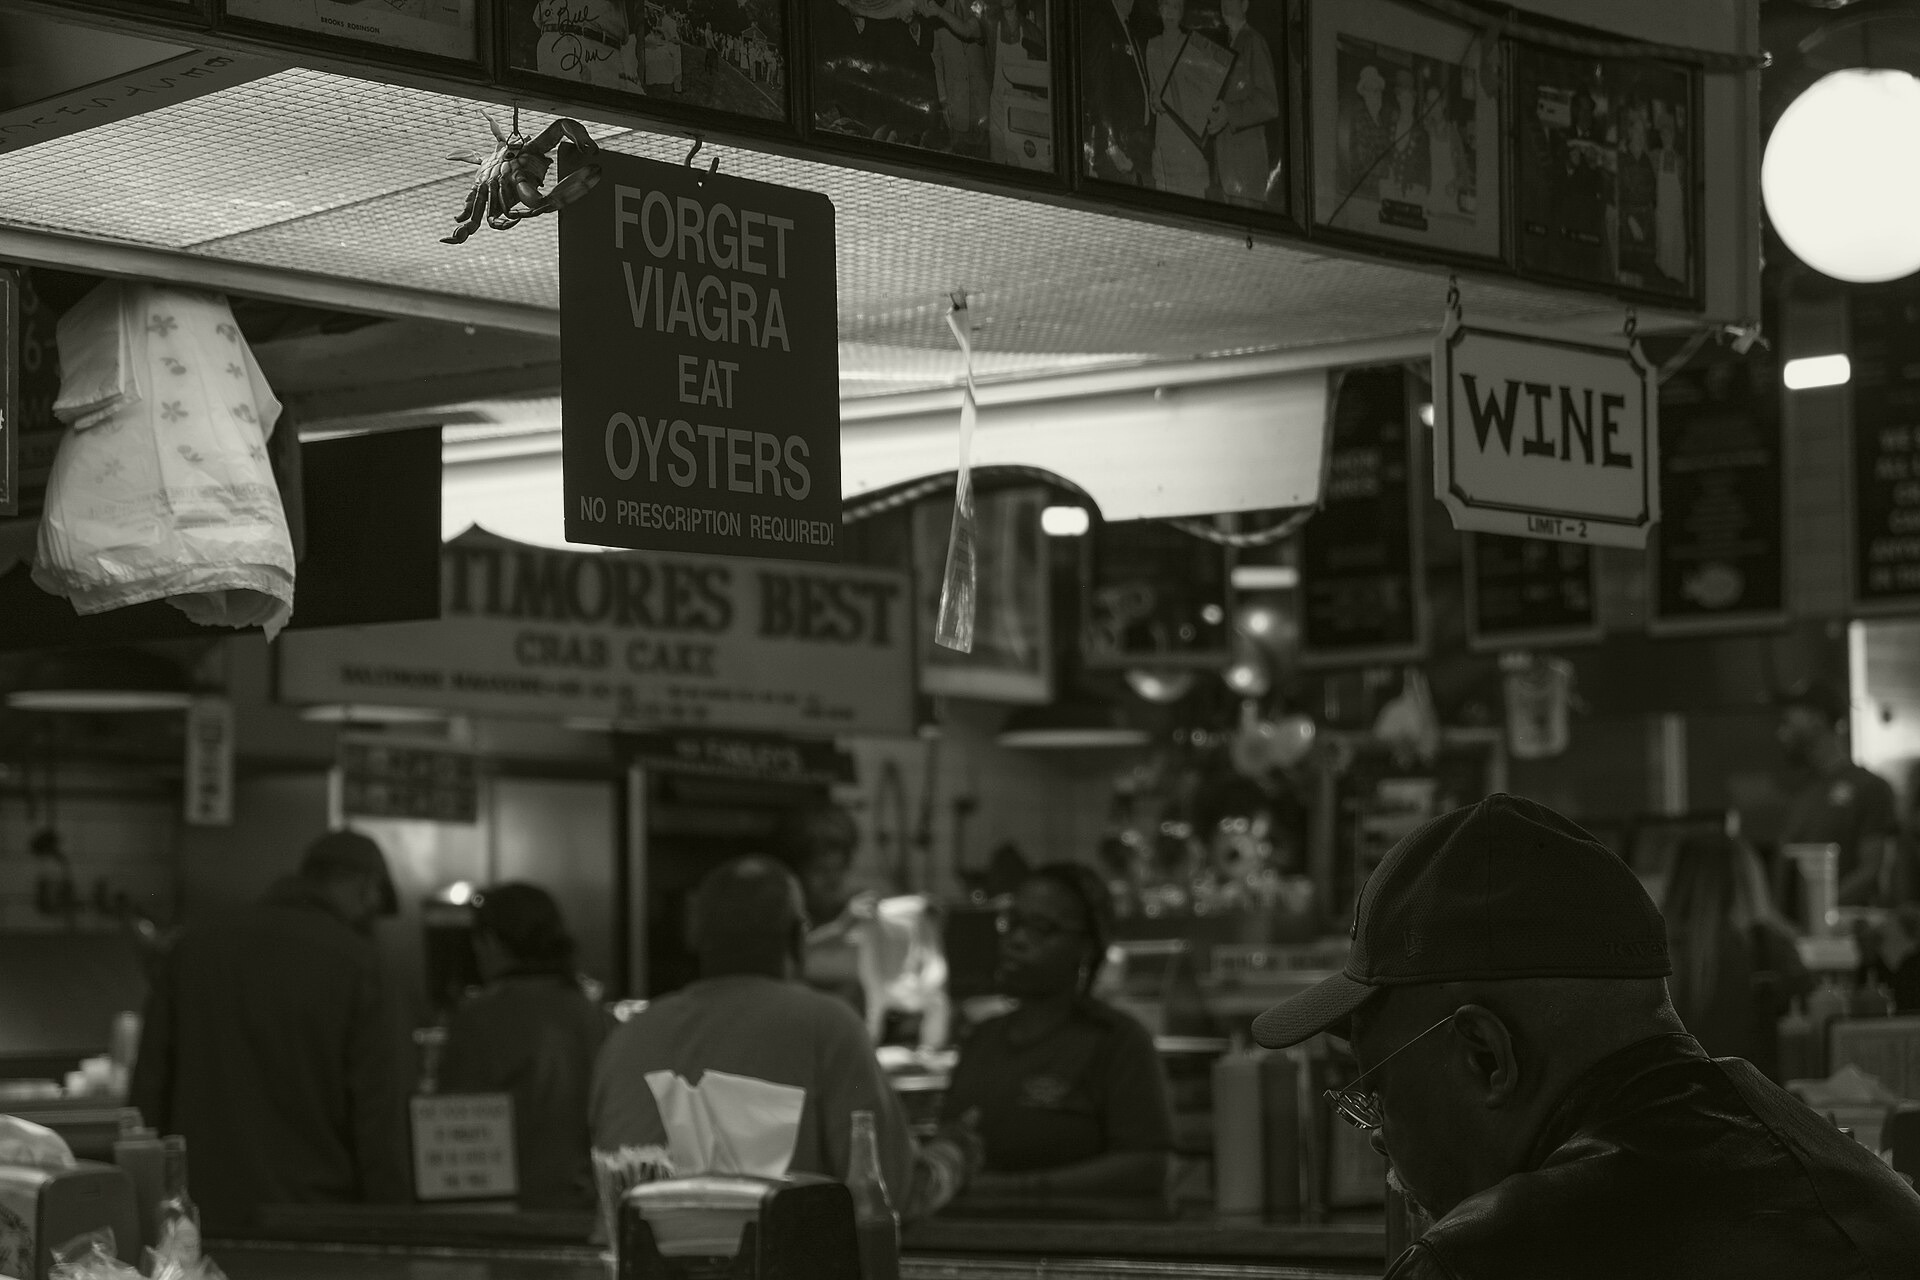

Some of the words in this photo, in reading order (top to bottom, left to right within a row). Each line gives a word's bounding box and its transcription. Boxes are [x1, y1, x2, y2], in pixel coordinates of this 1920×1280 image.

[320, 16, 345, 28] BROOKS
[346, 22, 381, 35] ROBINSON
[614, 183, 795, 279] FORGET
[622, 260, 791, 352] VIAGRA
[678, 353, 740, 409] EAT
[604, 411, 812, 502] OYSTERS
[1459, 372, 1634, 470] WINE
[580, 495, 607, 524] NO
[616, 498, 741, 538] PRESCRIPTION
[750, 513, 835, 548] REQUIRED!
[756, 570, 900, 646] BEST
[514, 630, 611, 669] CRAB
[625, 636, 716, 677] CAKE
